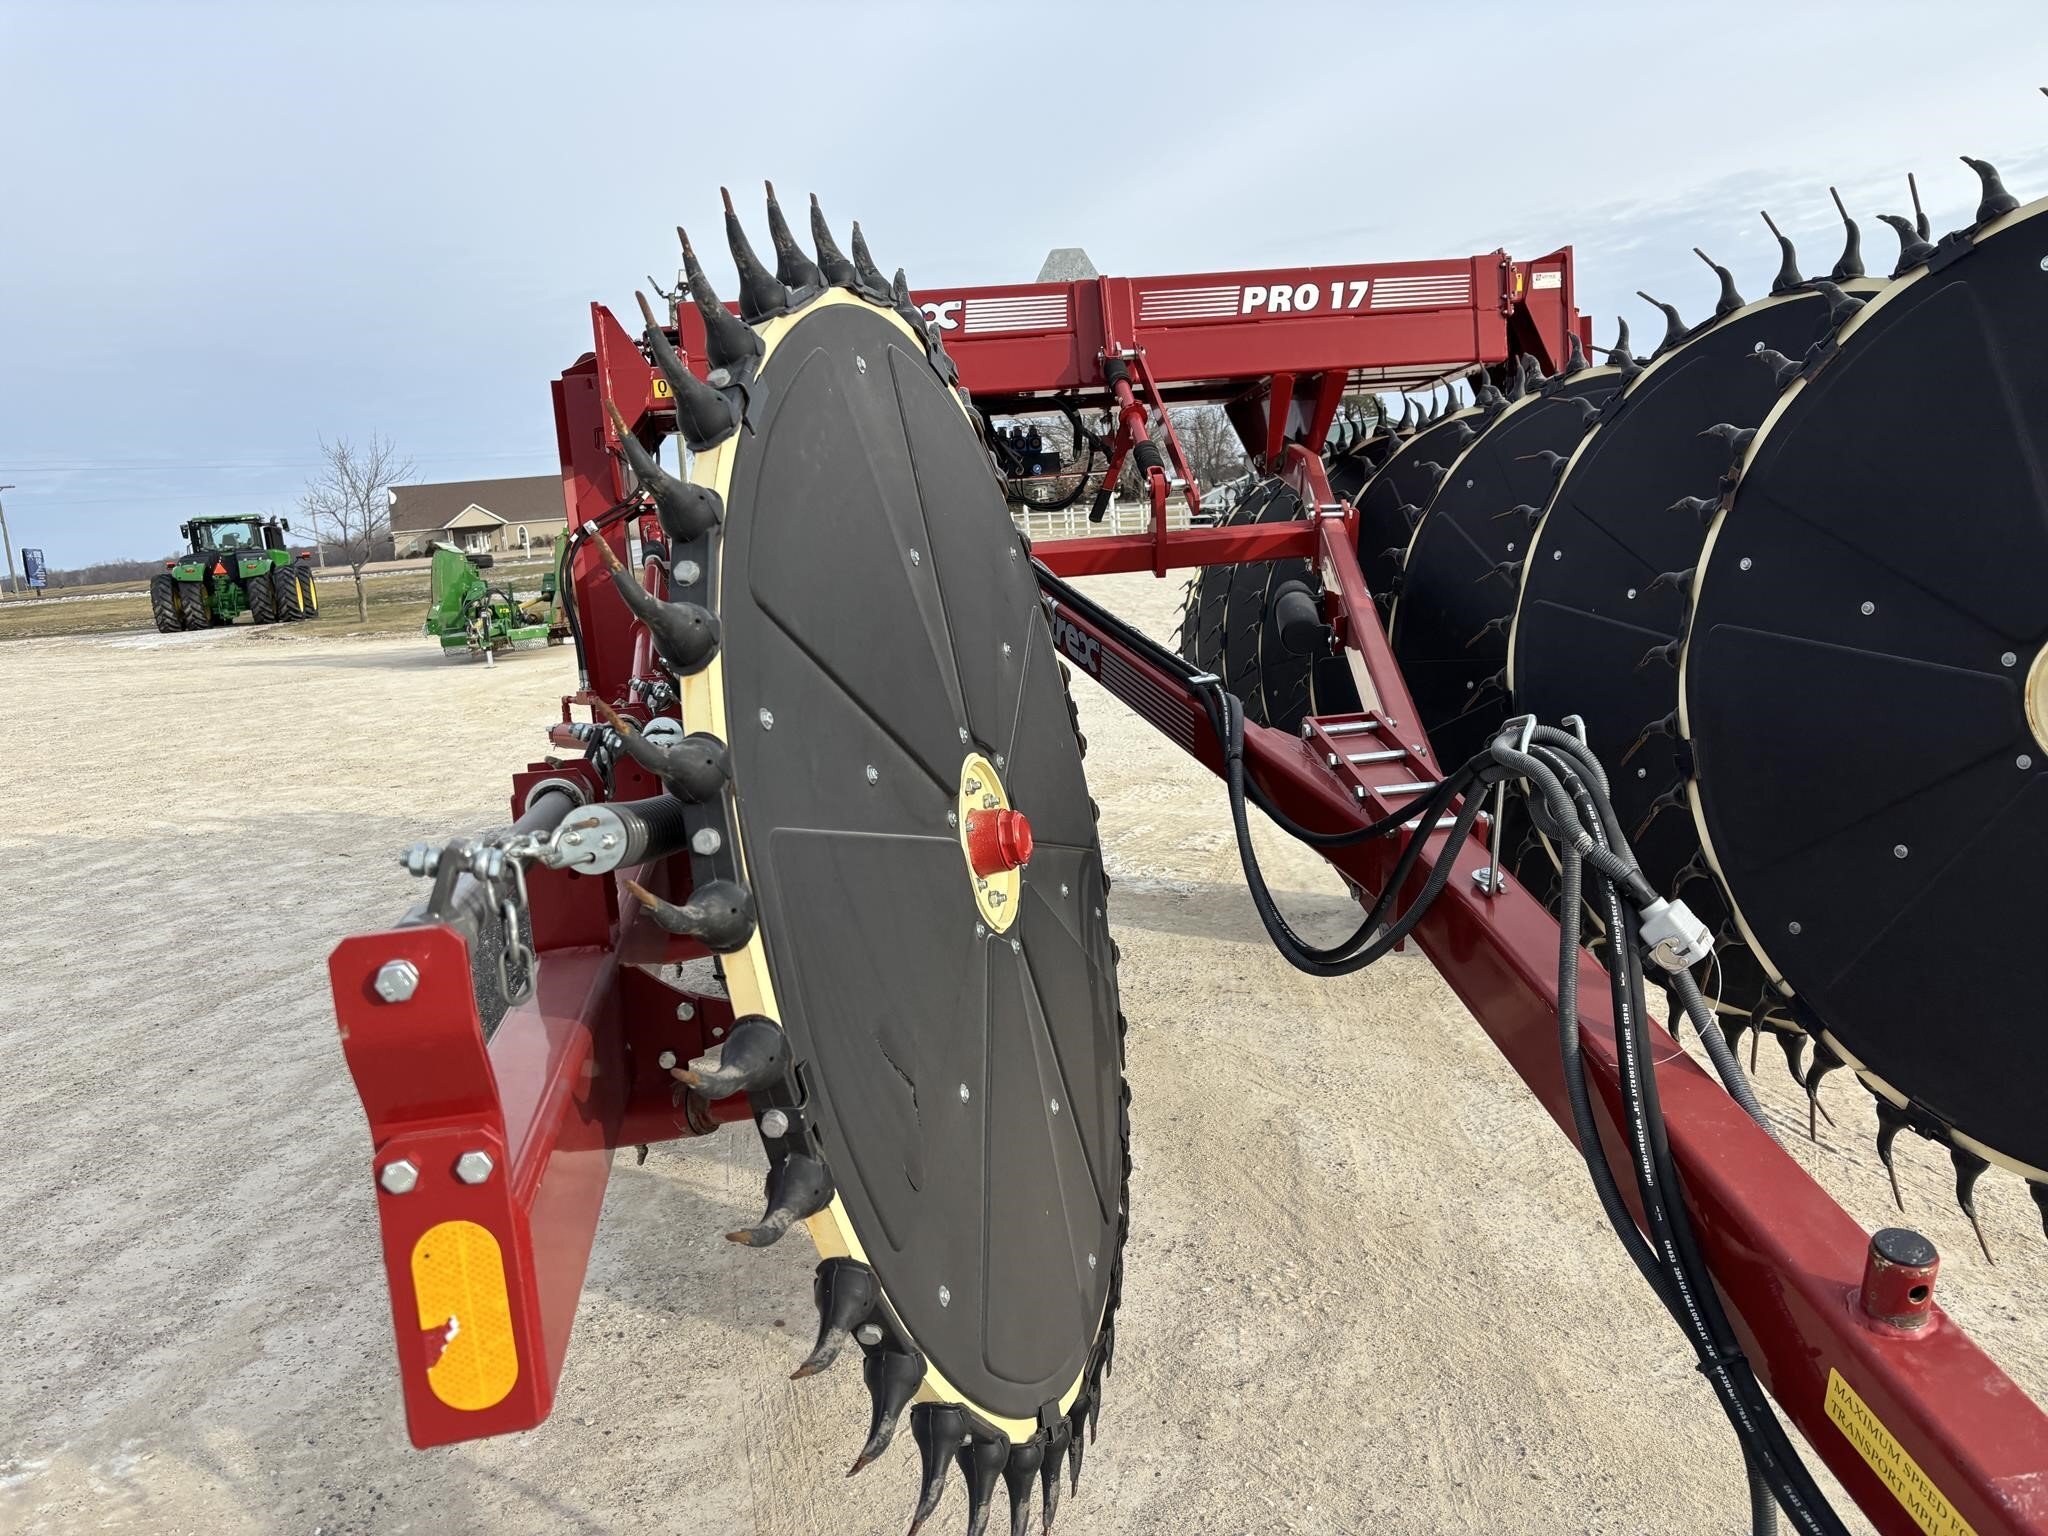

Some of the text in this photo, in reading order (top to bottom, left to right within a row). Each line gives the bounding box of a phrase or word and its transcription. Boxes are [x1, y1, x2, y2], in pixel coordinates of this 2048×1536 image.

[1241, 281, 1369, 314] PRO 17
[1635, 1118, 1643, 1130] WP
[1637, 1130, 1645, 1143] 330
[1683, 1294, 1694, 1308] SAE
[1689, 1308, 1700, 1321] 100
[1720, 1375, 1732, 1388] 330
[1831, 1399, 1938, 1535] TRANSPORT MPH
[1834, 1379, 1901, 1464] MAXIMUM
[1903, 1463, 1947, 1518] SPEED
